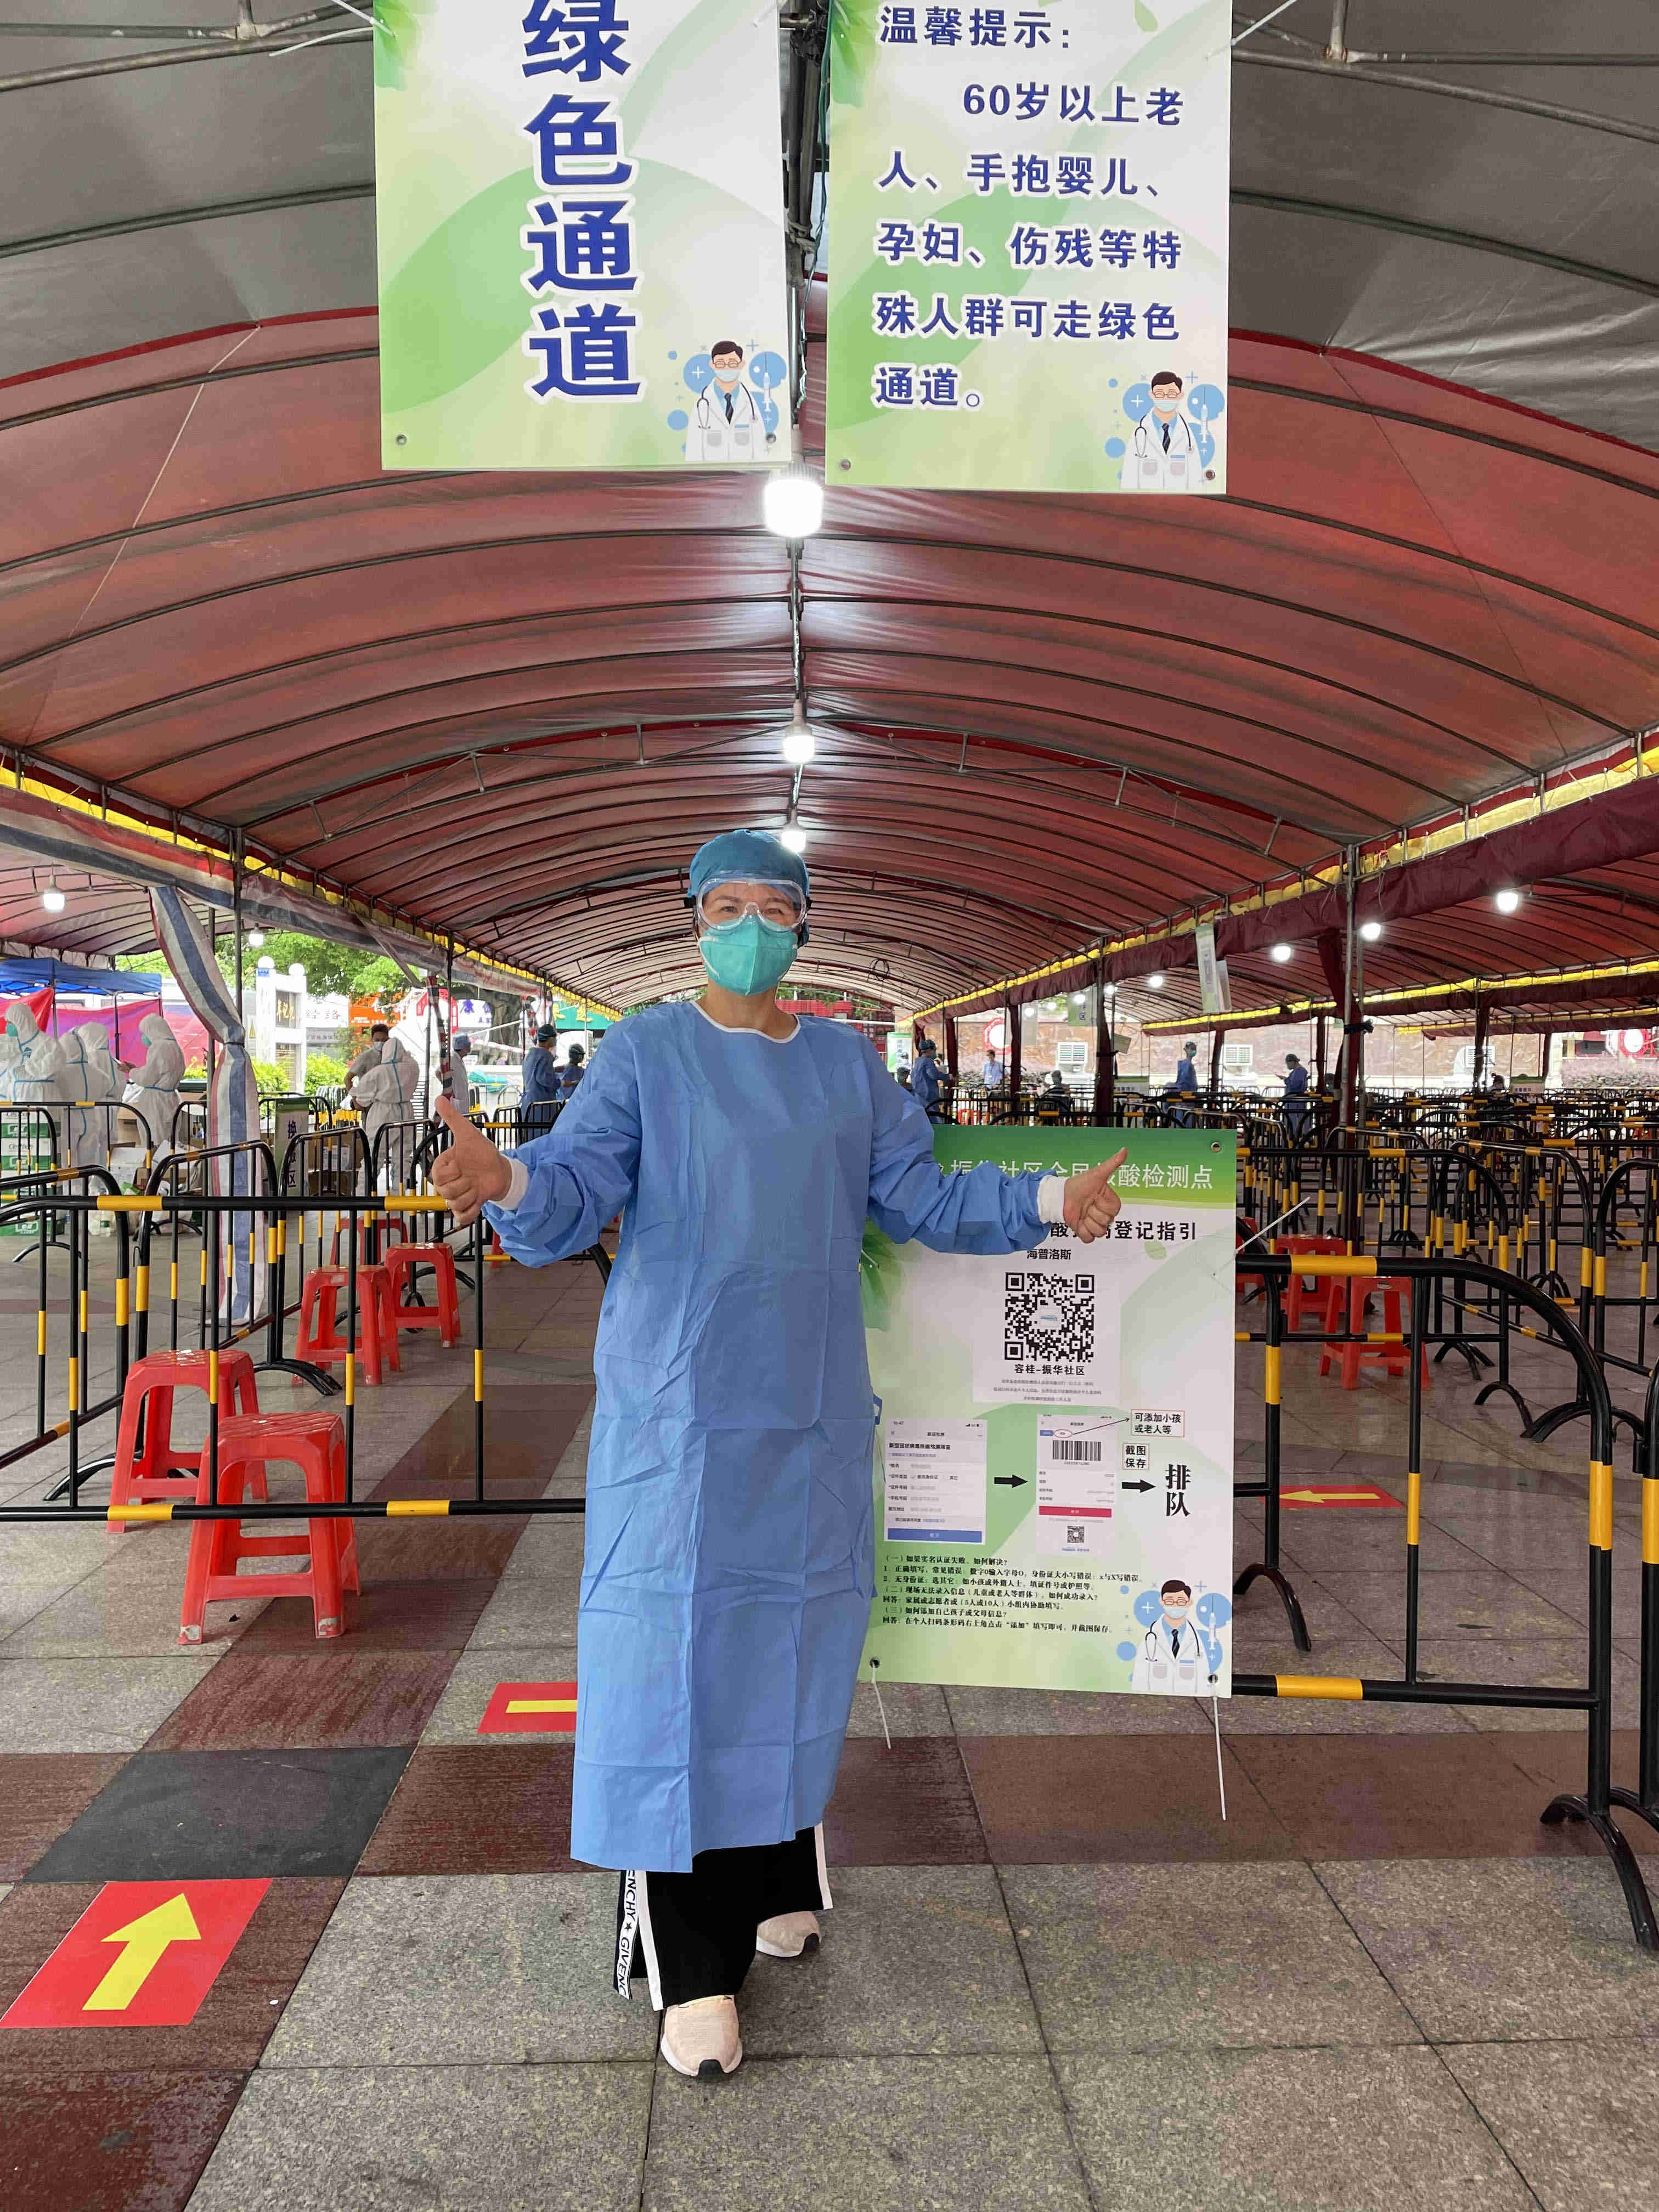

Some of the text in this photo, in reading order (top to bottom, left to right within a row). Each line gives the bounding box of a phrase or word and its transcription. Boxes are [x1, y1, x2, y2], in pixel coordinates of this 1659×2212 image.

[963, 81, 1183, 127] 60岁以上老
[878, 151, 1159, 196] 人、手抱婴儿、
[521, 0, 641, 398] 绿色通道
[878, 222, 1182, 269] 孕妇、伤残等特
[876, 295, 1180, 340] 殊人群可走绿色
[875, 366, 981, 407] 通道。
[1050, 1221, 1196, 1240] 酸登记指引
[1026, 1249, 1071, 1260] 海普洛斯
[1134, 1413, 1181, 1423] 可添加小孩
[1134, 1425, 1172, 1434] 或老人等
[1125, 1446, 1146, 1456] 截图
[1125, 1458, 1146, 1468] 保存
[1165, 1464, 1191, 1517] 排队
